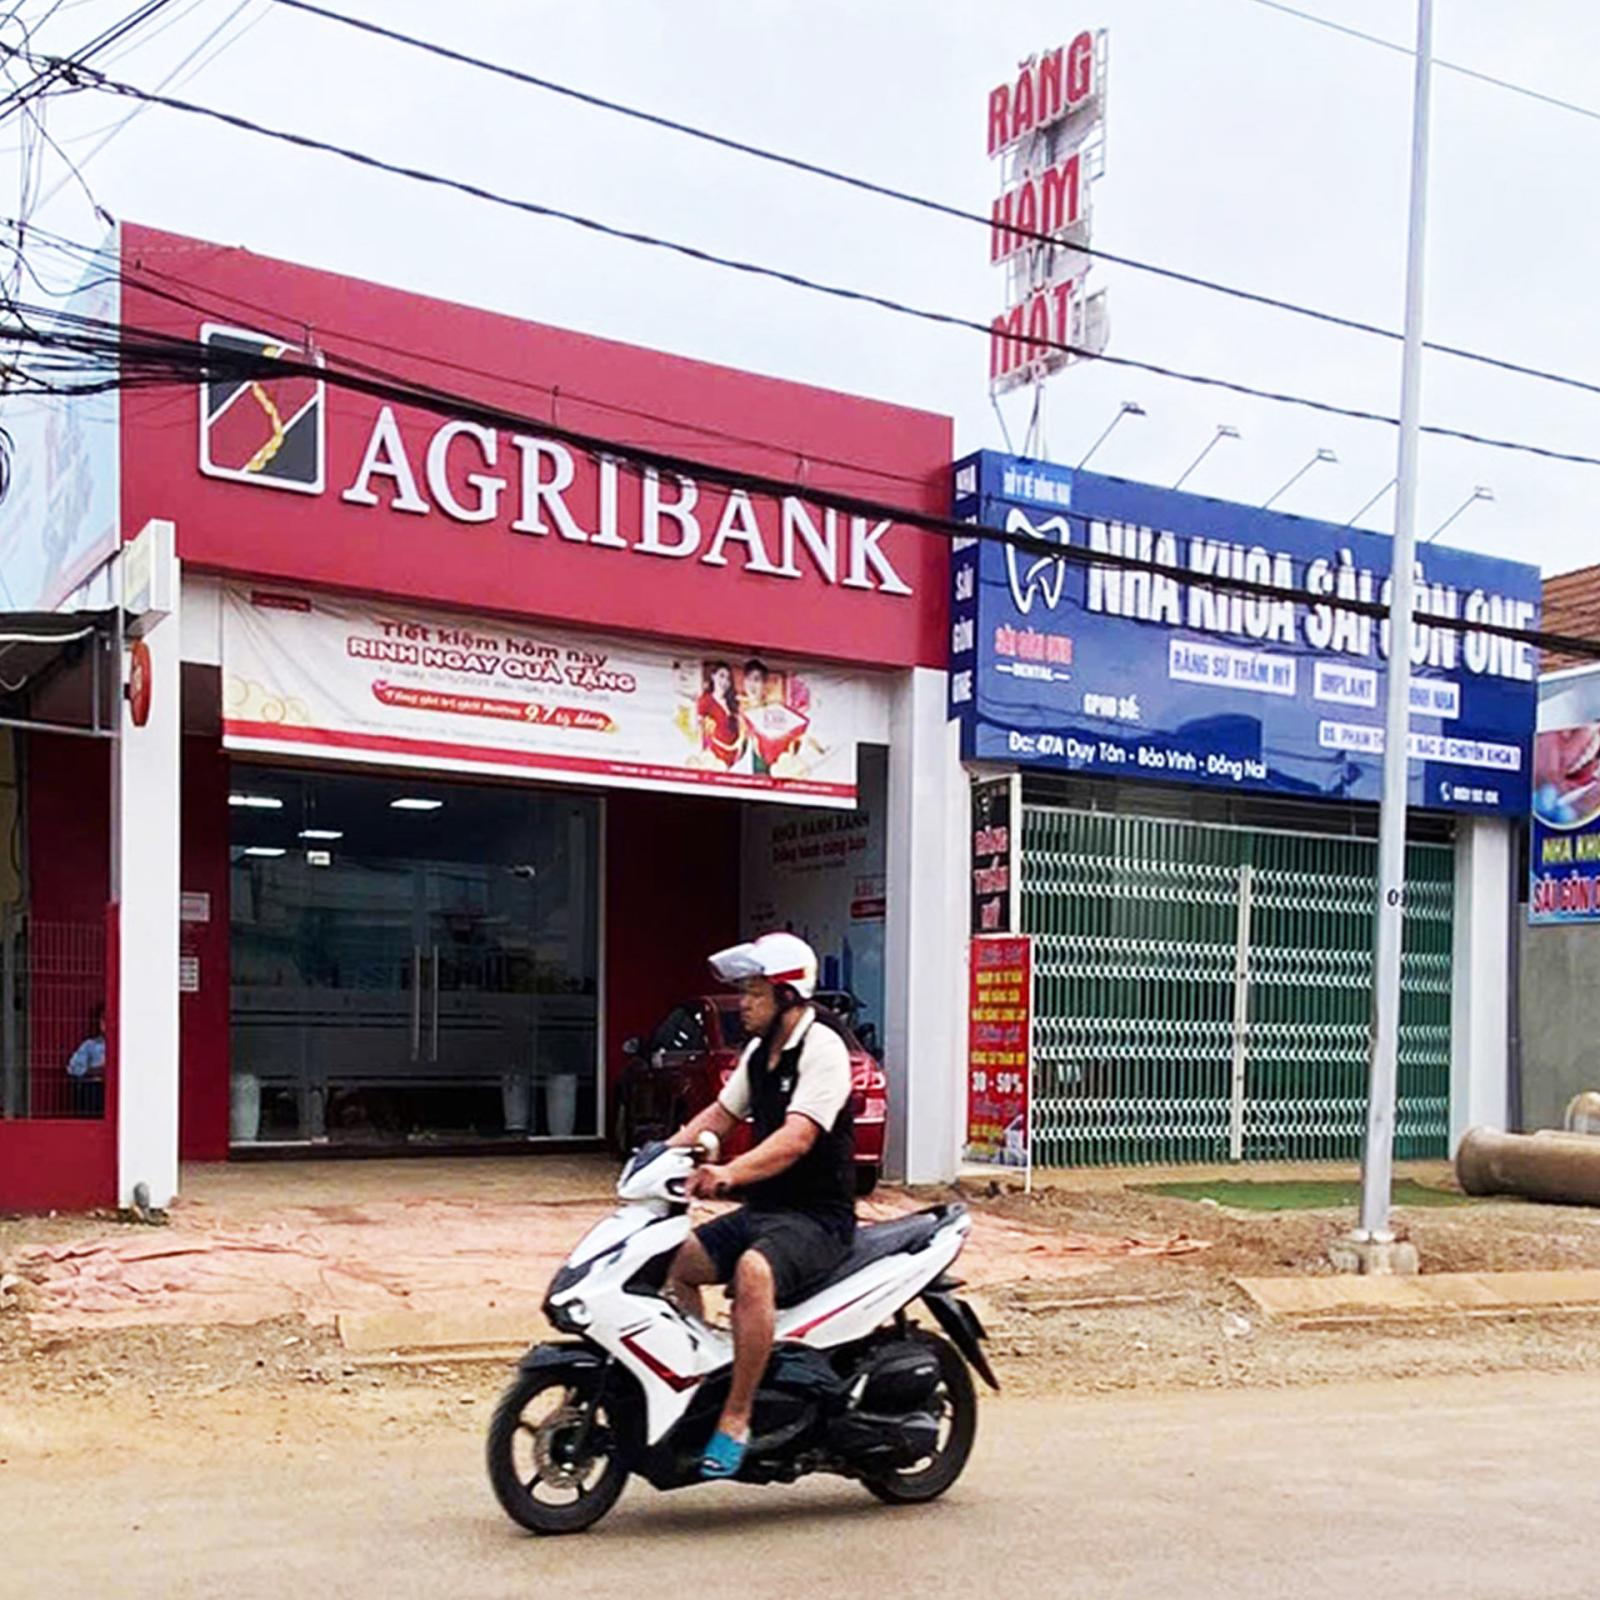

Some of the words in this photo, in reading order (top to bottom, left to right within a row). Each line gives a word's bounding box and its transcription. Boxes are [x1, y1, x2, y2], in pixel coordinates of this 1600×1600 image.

[987, 30, 1092, 157] RĂNG
[989, 153, 1081, 264] HÀM
[342, 405, 914, 596] AGRIBANK
[1088, 520, 1182, 625] NHA
[1188, 536, 1296, 643] KHOA
[1305, 548, 1373, 655] SÀI
[1464, 589, 1535, 682] ONE
[348, 637, 418, 666] RINH
[422, 647, 500, 676] NGAY
[502, 655, 563, 684] QUÀ
[565, 666, 637, 693] TẶNG
[380, 620, 430, 642] Tiết
[438, 627, 498, 653] kiệm
[506, 637, 559, 661] hôm
[566, 648, 608, 668] nay
[1173, 647, 1210, 676] RĂNG
[1036, 735, 1064, 757] 47A
[1067, 739, 1097, 763] Duy
[1099, 742, 1126, 764] Tân
[1166, 748, 1197, 771] Vinh
[1245, 760, 1267, 780] Nai
